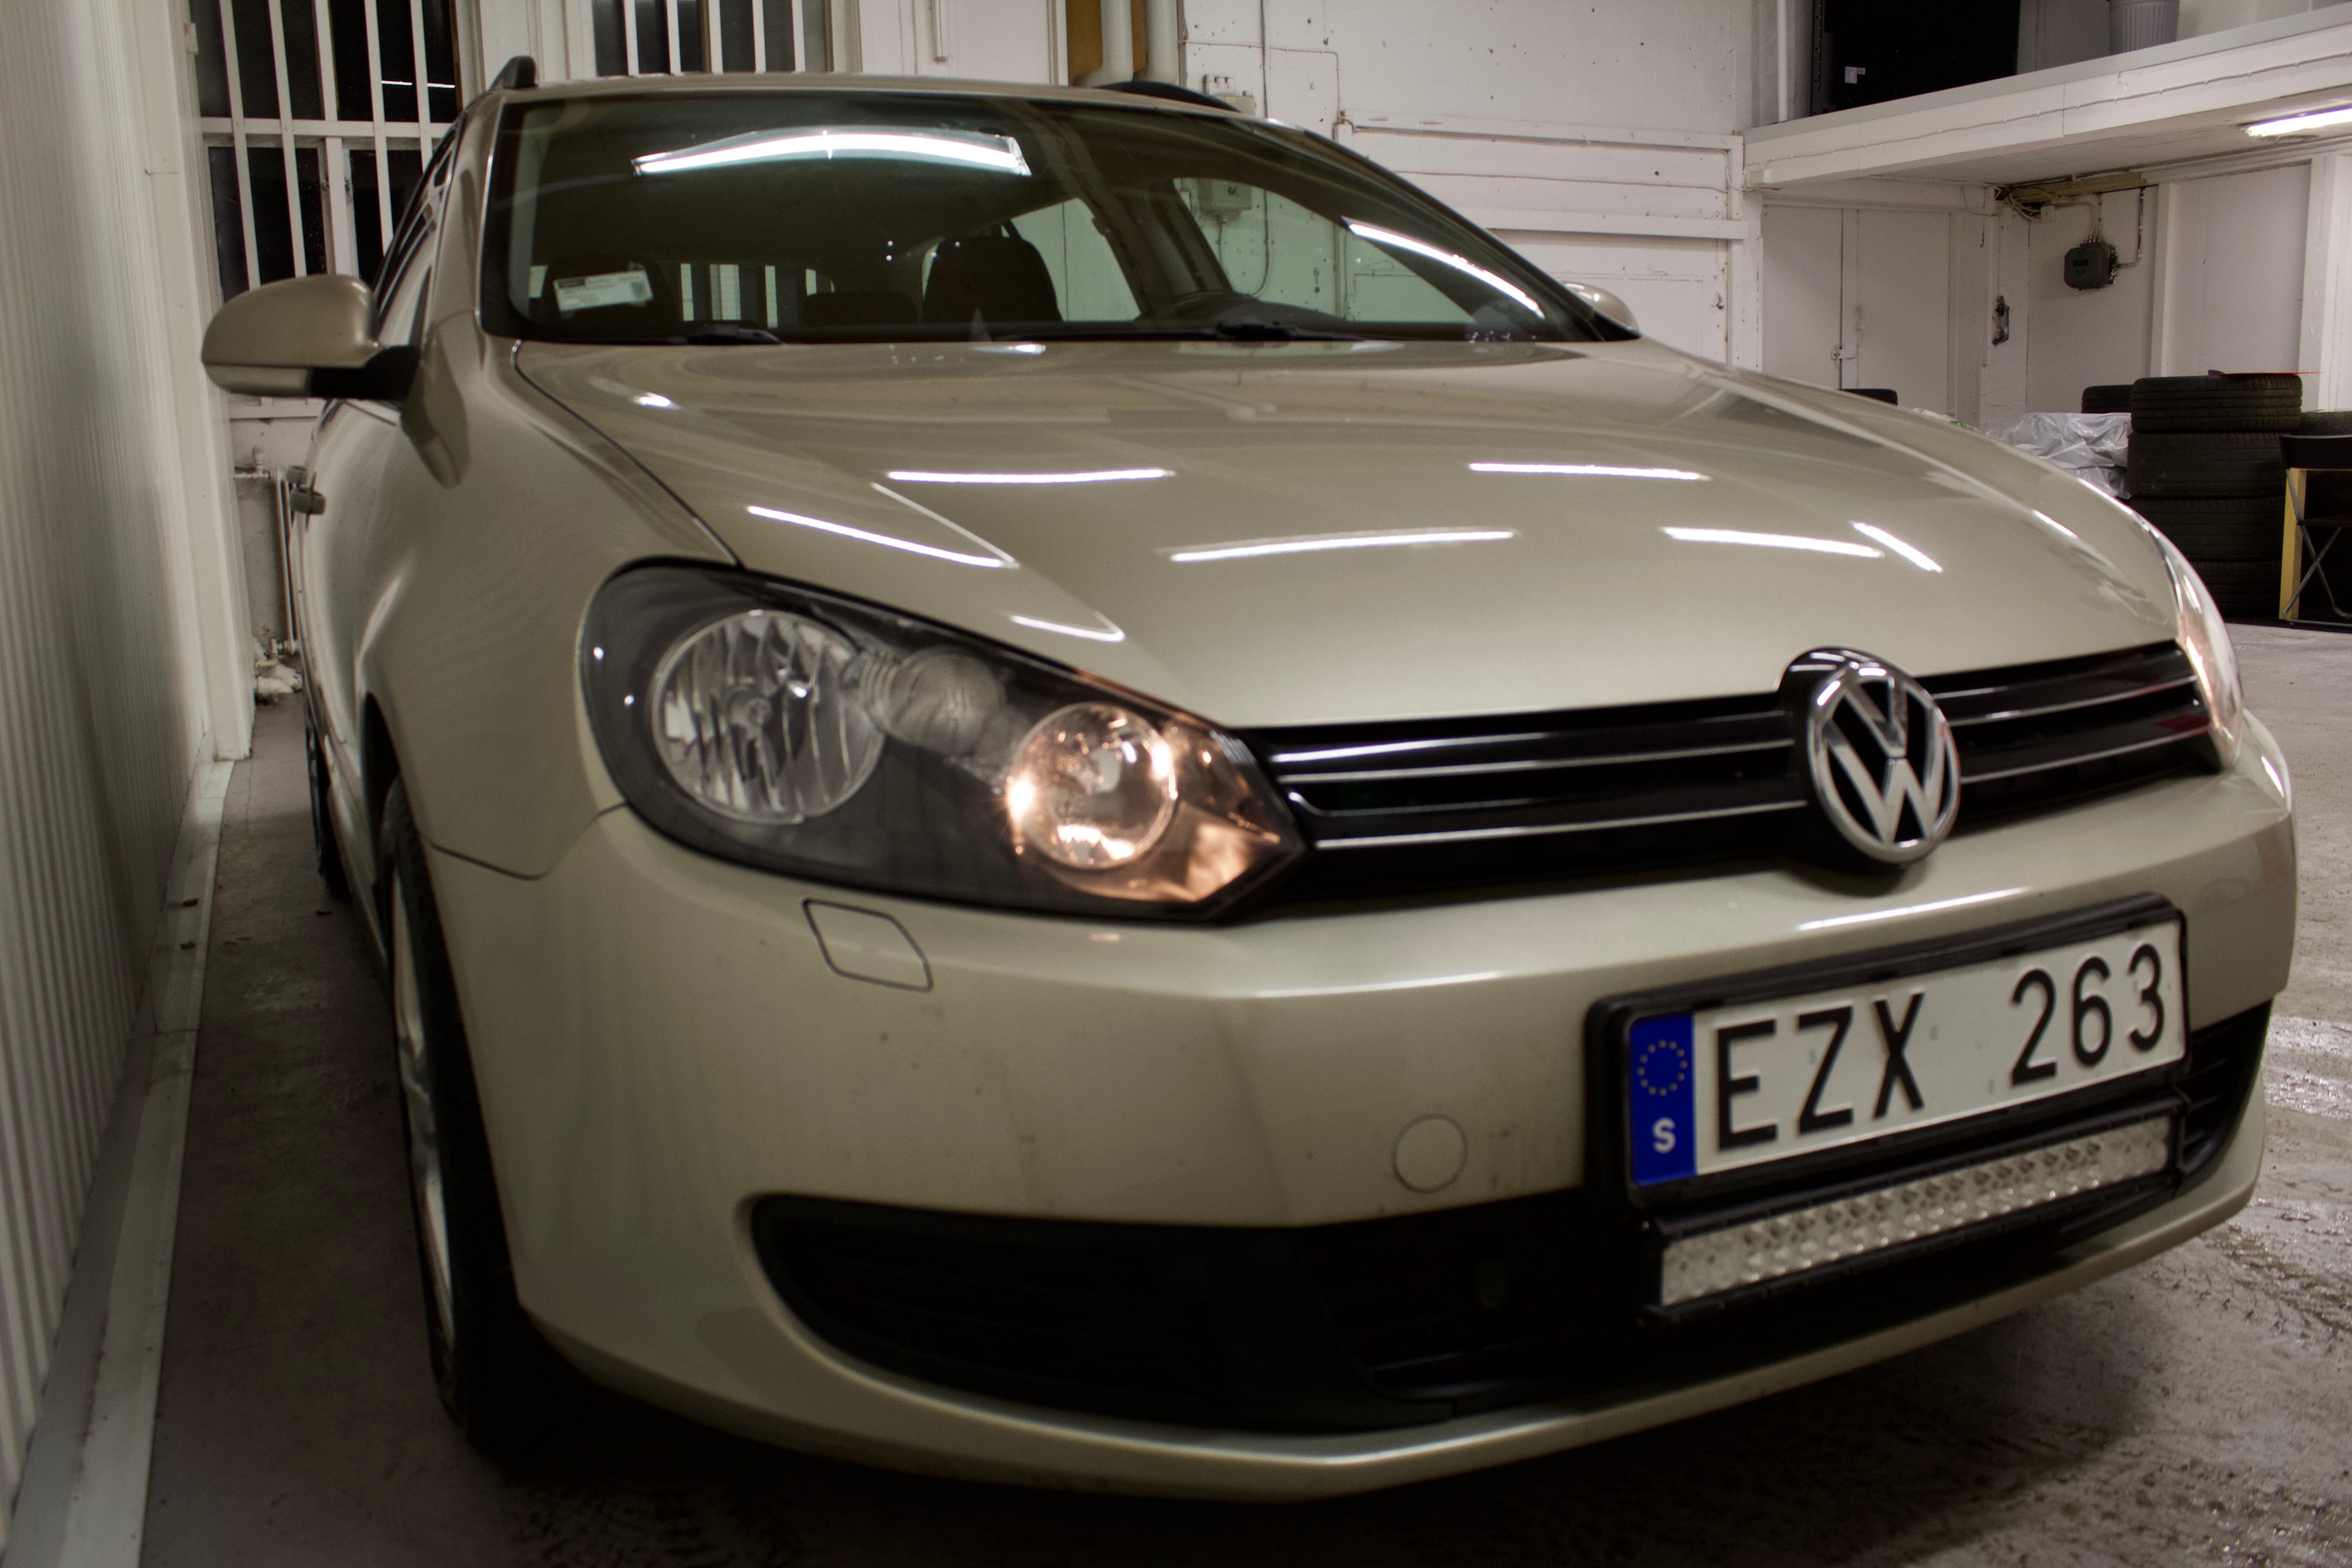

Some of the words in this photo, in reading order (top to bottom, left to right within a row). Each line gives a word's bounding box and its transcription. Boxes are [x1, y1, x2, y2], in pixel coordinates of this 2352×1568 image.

[1715, 993, 1924, 1152] EZX
[2011, 944, 2165, 1087] 263
[1653, 1118, 1676, 1152] S
